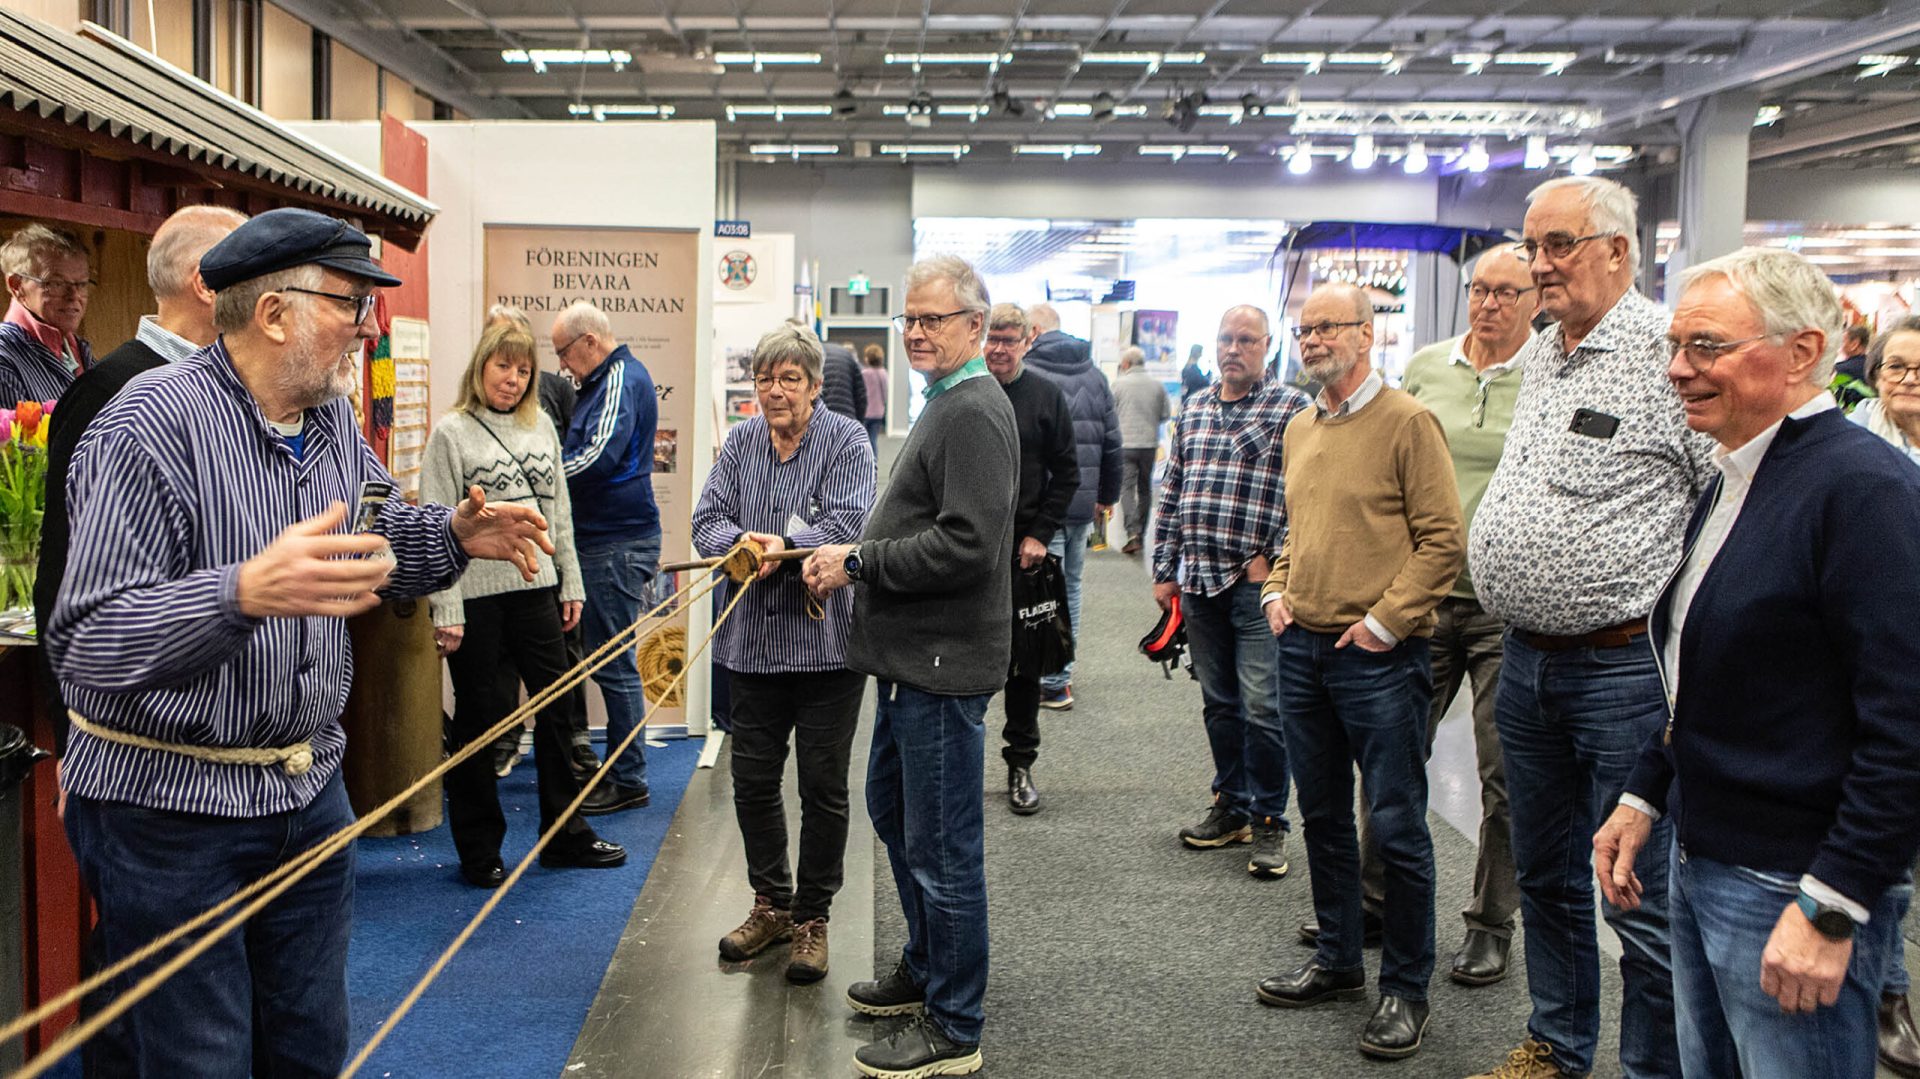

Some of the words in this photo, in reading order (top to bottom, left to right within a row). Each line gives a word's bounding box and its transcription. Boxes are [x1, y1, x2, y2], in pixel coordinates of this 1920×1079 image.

[718, 224, 749, 236] A03:08
[526, 247, 658, 268] FÖRENINGEN
[553, 273, 631, 291] BEVARA
[1019, 600, 1057, 619] FLADEN
